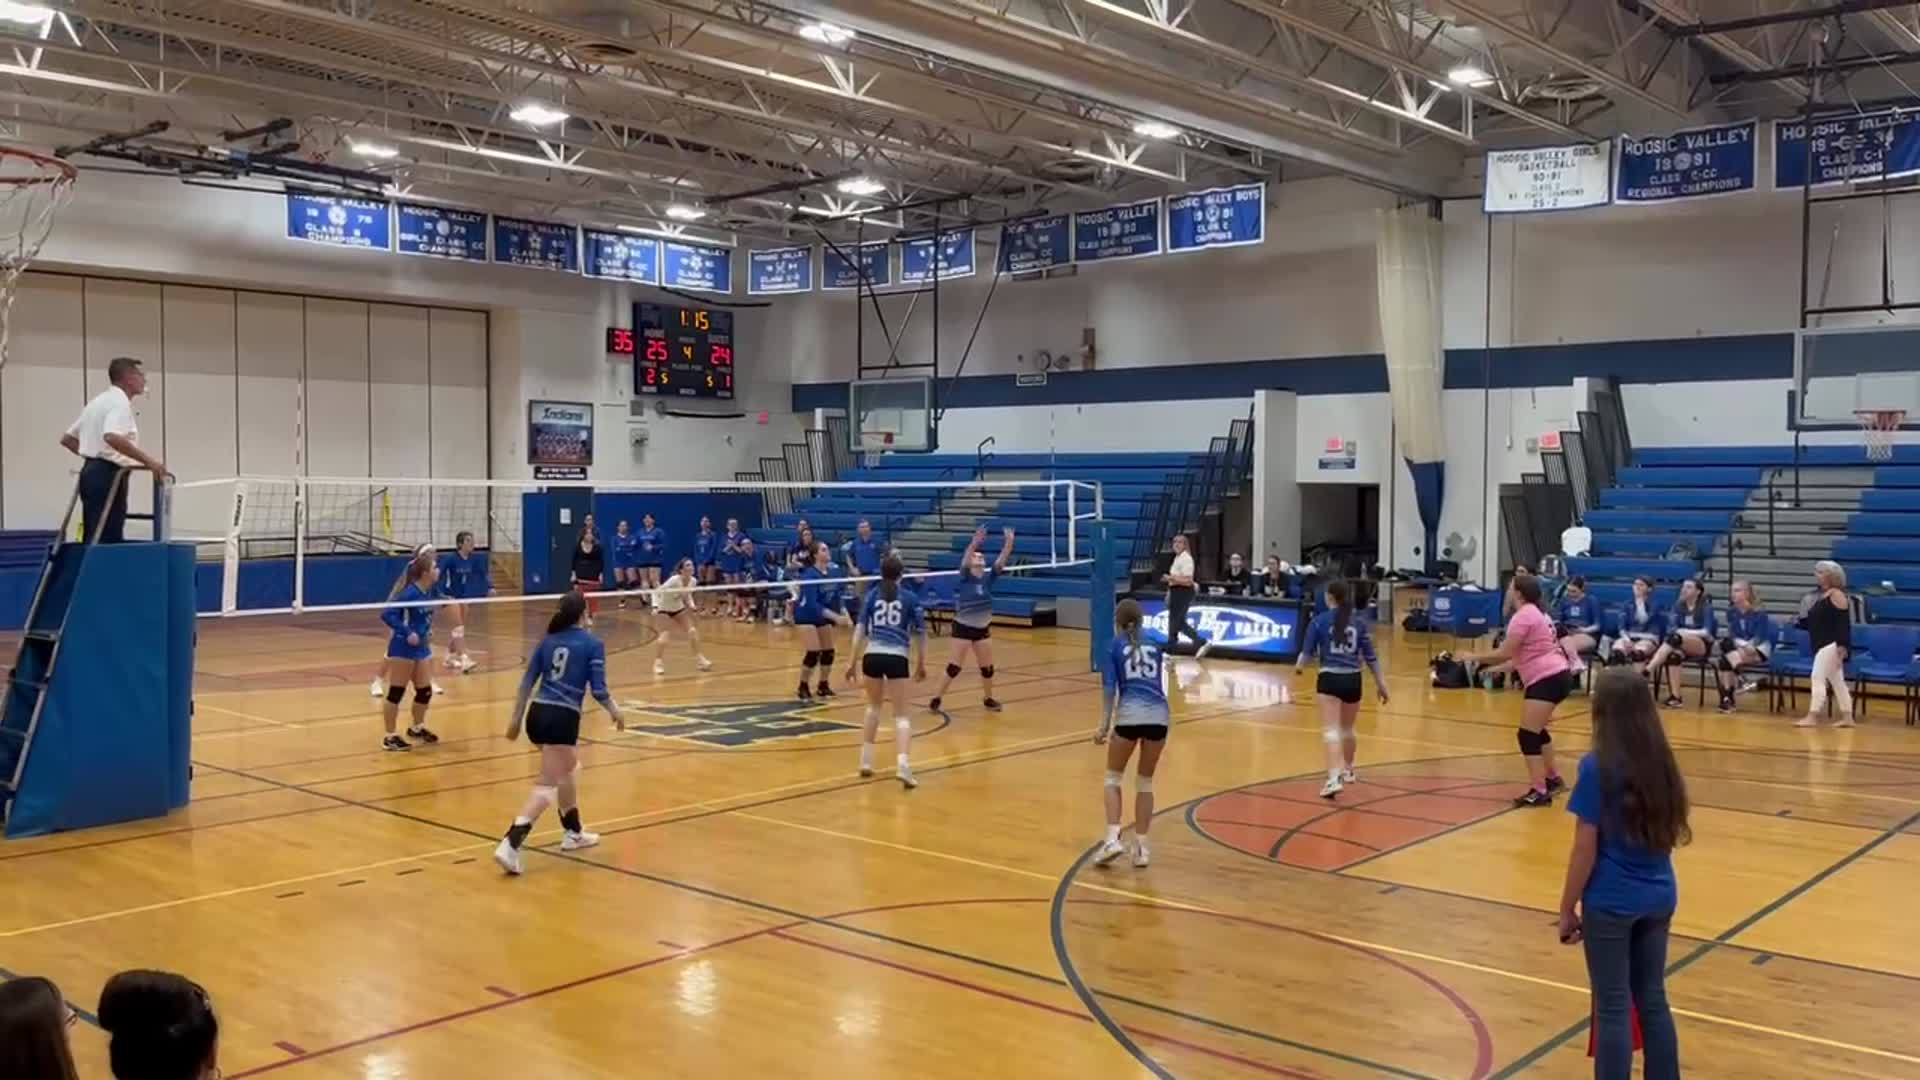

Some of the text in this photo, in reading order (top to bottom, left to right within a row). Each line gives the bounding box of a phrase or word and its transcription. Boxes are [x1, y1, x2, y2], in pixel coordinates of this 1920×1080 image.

[1572, 146, 1600, 158] GIRLS
[1624, 127, 1751, 156] HOOSIC VALLEY
[1518, 160, 1577, 172] BASKETBALL
[1627, 177, 1742, 199] REGIONAL CHAMPIONS
[1649, 173, 1681, 186] CLASS
[1235, 189, 1260, 202] BOYS
[1076, 203, 1156, 225] HOOSIC VALLEY
[613, 330, 634, 352] 35
[646, 339, 732, 366] 25 4 24
[646, 367, 656, 385] 2
[873, 600, 903, 626] 26
[1235, 620, 1292, 639] VALLEY
[551, 647, 570, 681] 9
[1122, 644, 1159, 680] 25
